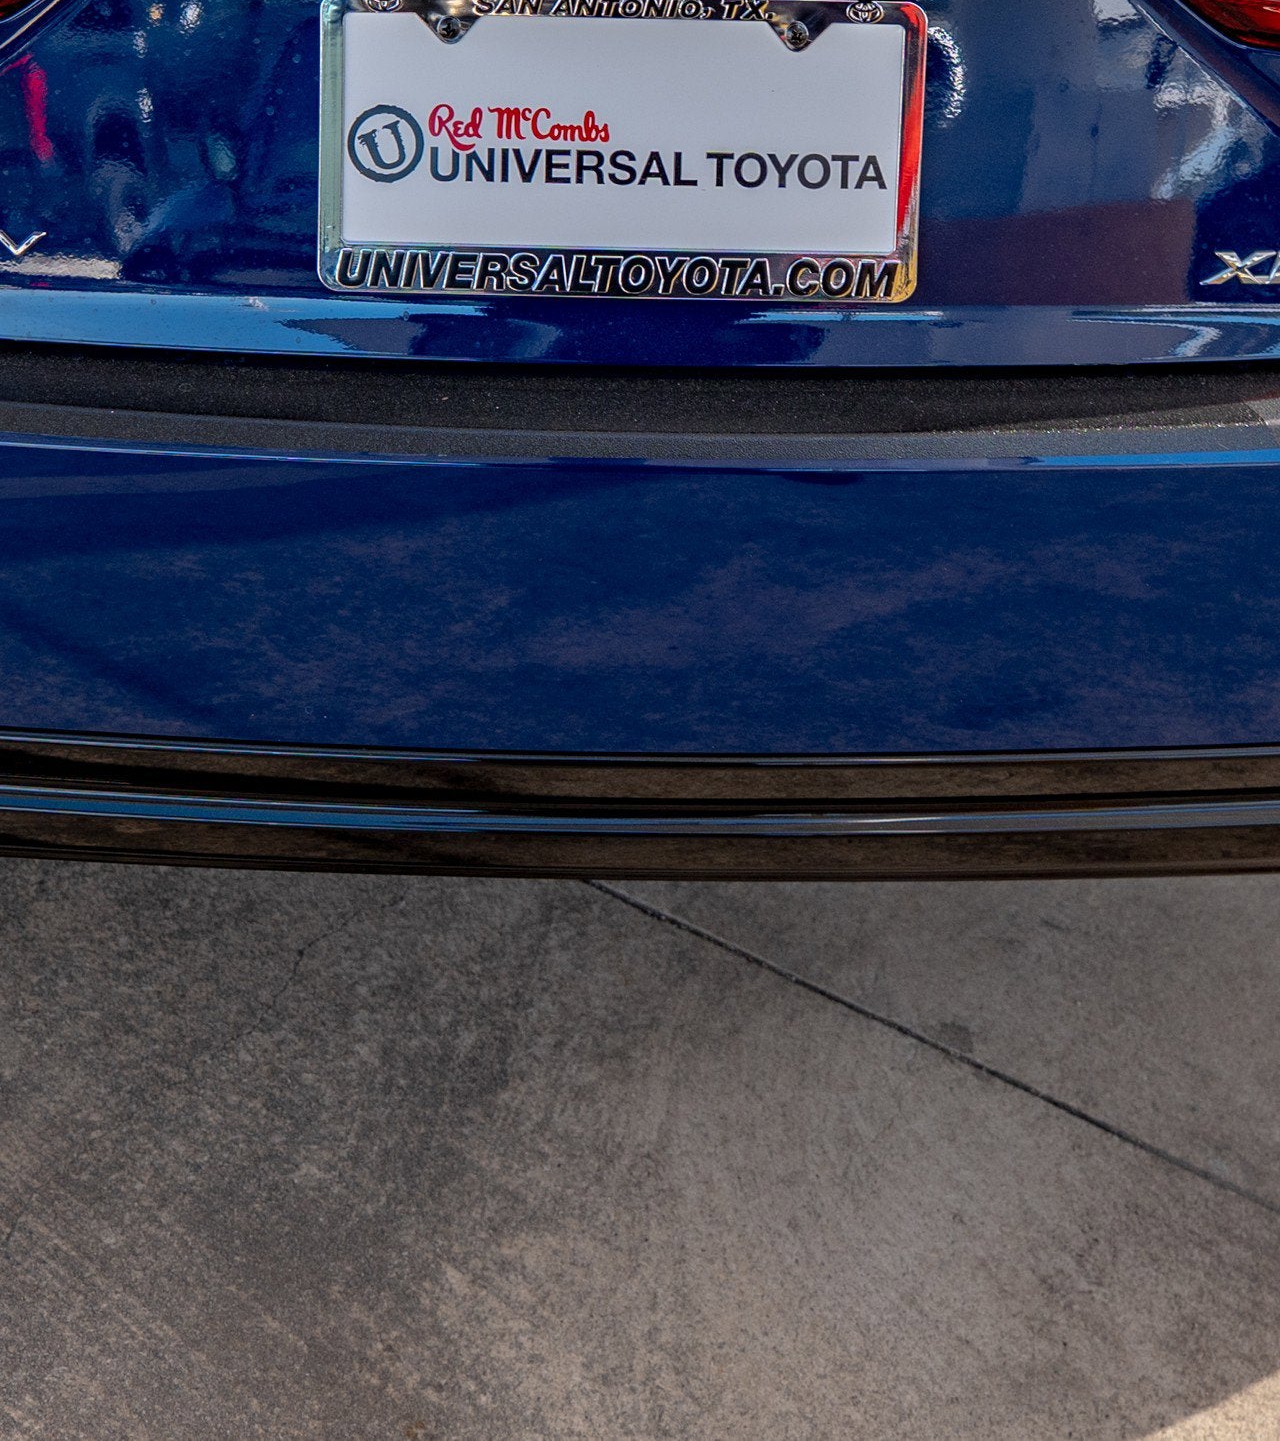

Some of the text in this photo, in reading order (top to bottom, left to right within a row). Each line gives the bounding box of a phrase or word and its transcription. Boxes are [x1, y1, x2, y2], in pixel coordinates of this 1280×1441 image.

[428, 103, 610, 152] Red McCombs
[430, 146, 888, 190] UNIVERSAL TOYOTA
[335, 247, 902, 300] UNIVERSALTOYOTA.COM
